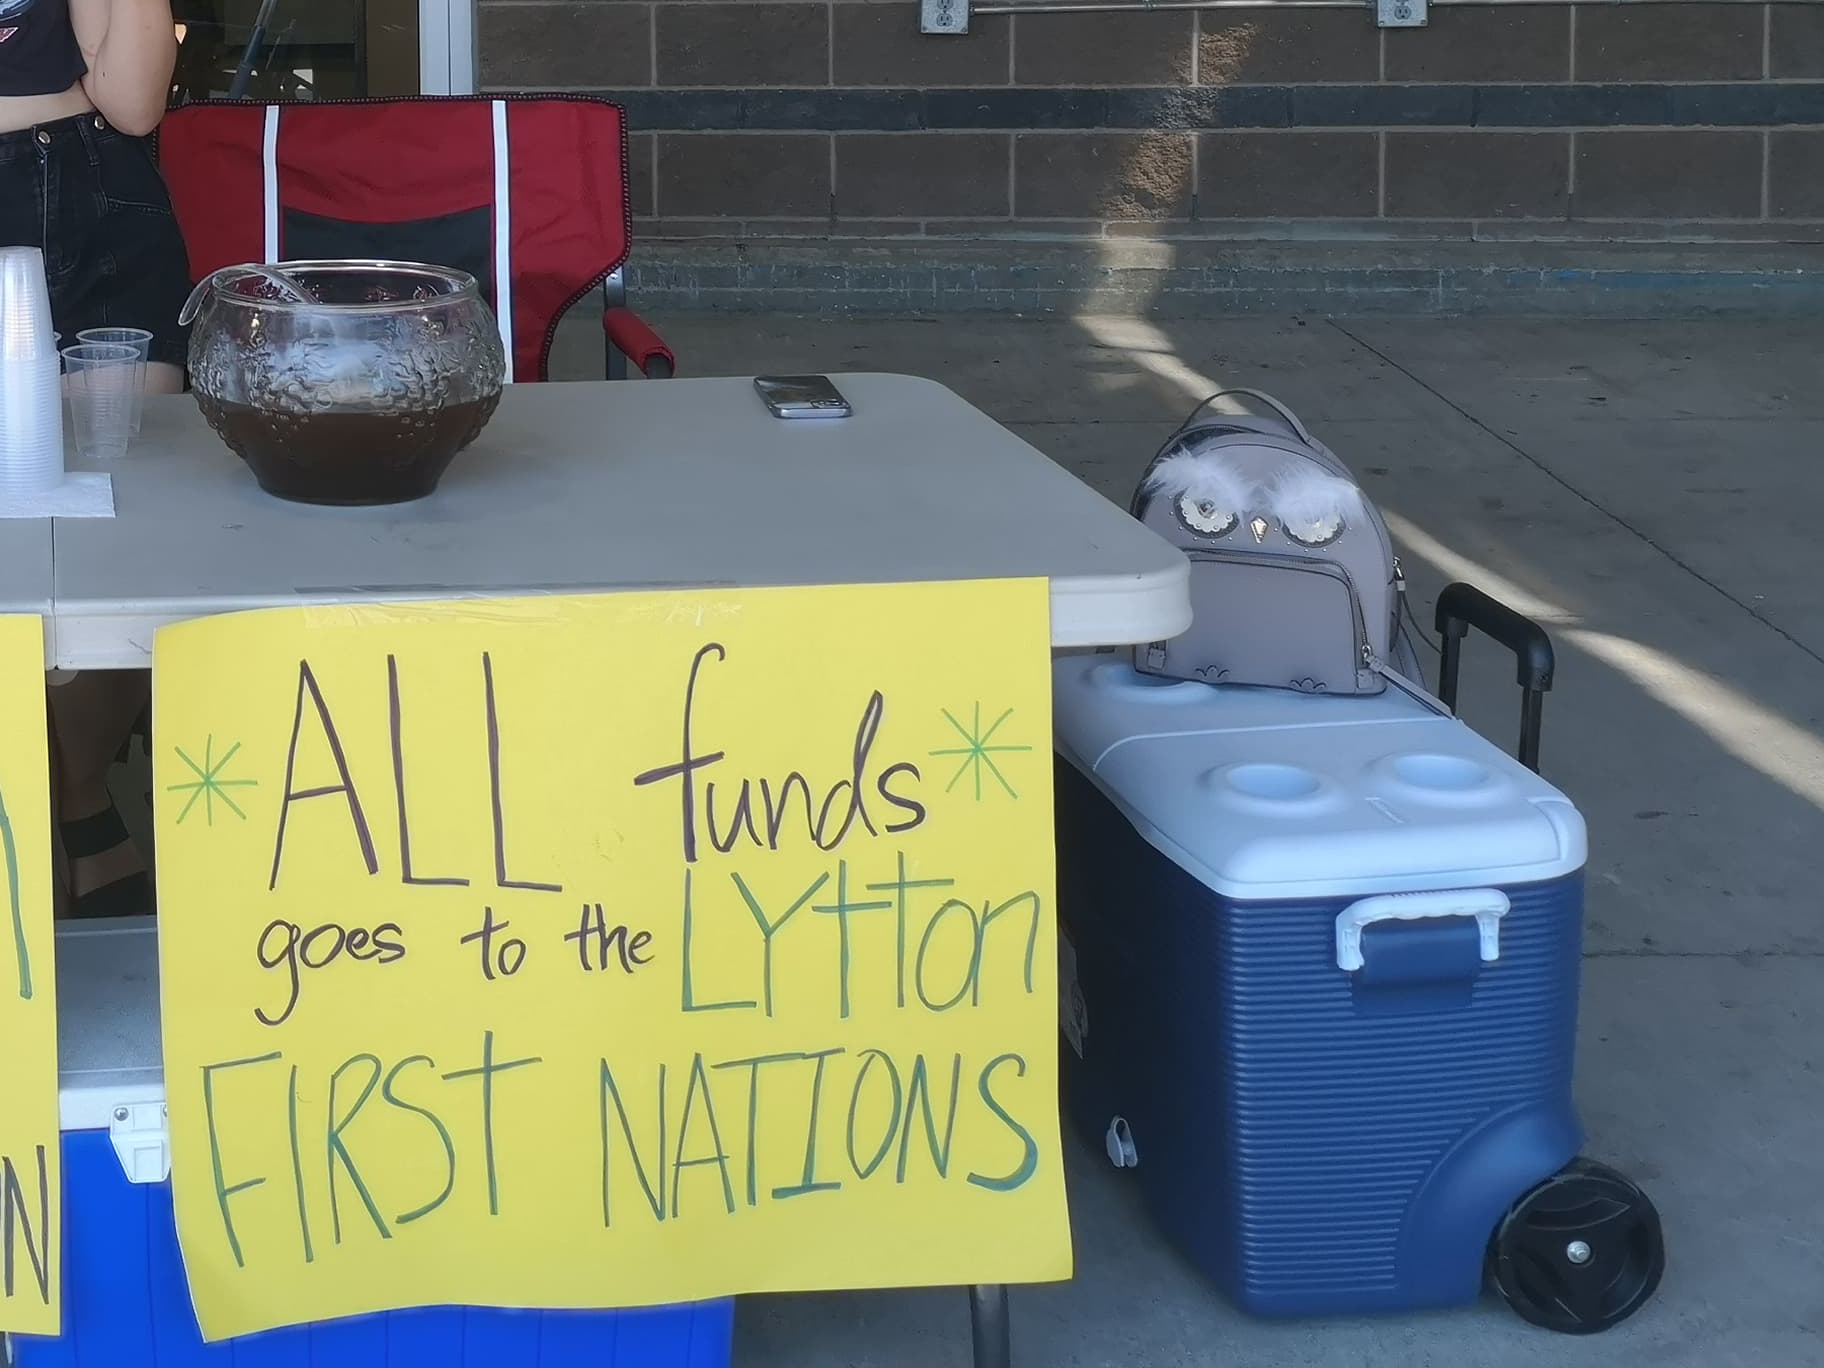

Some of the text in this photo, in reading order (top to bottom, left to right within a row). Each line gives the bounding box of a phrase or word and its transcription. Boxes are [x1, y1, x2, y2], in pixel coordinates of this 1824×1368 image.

[267, 641, 928, 892] ALL funds
[253, 916, 407, 1027] goes
[460, 905, 527, 981] to
[563, 902, 657, 975] the
[199, 1029, 1039, 1269] FIRST NATIONS
